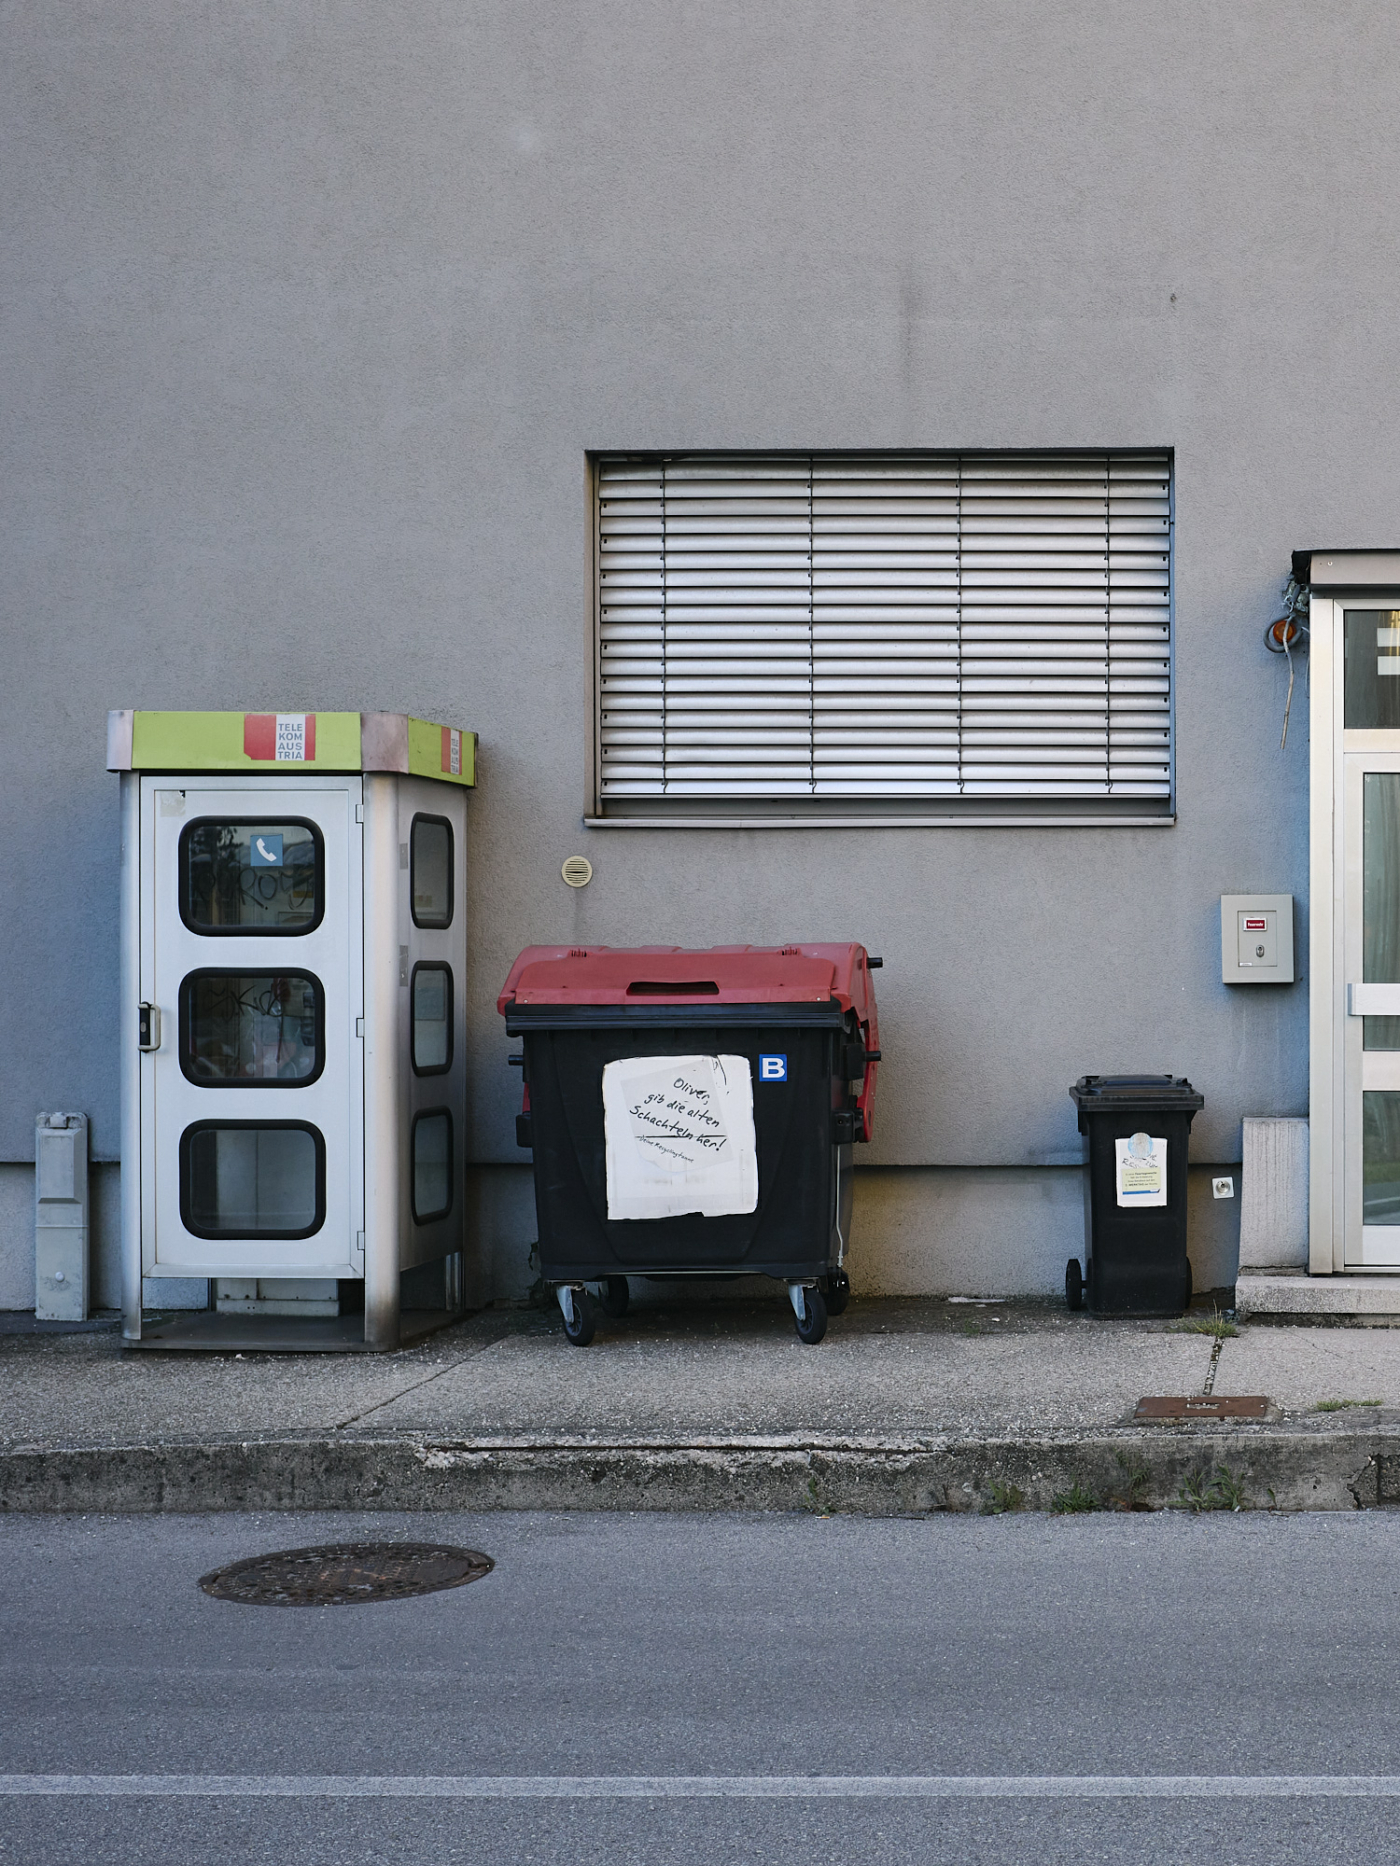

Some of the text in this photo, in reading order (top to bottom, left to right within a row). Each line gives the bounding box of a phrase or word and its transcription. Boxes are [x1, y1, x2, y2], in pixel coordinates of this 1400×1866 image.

[278, 723, 303, 731] TELE
[278, 732, 303, 741] KOM
[278, 742, 303, 750] AUS
[277, 751, 303, 759] TRIA
[761, 1057, 786, 1079] B
[673, 1077, 710, 1106] Oliver,
[643, 1093, 720, 1128] gib die alten
[629, 1105, 728, 1152] Schachteln her!
